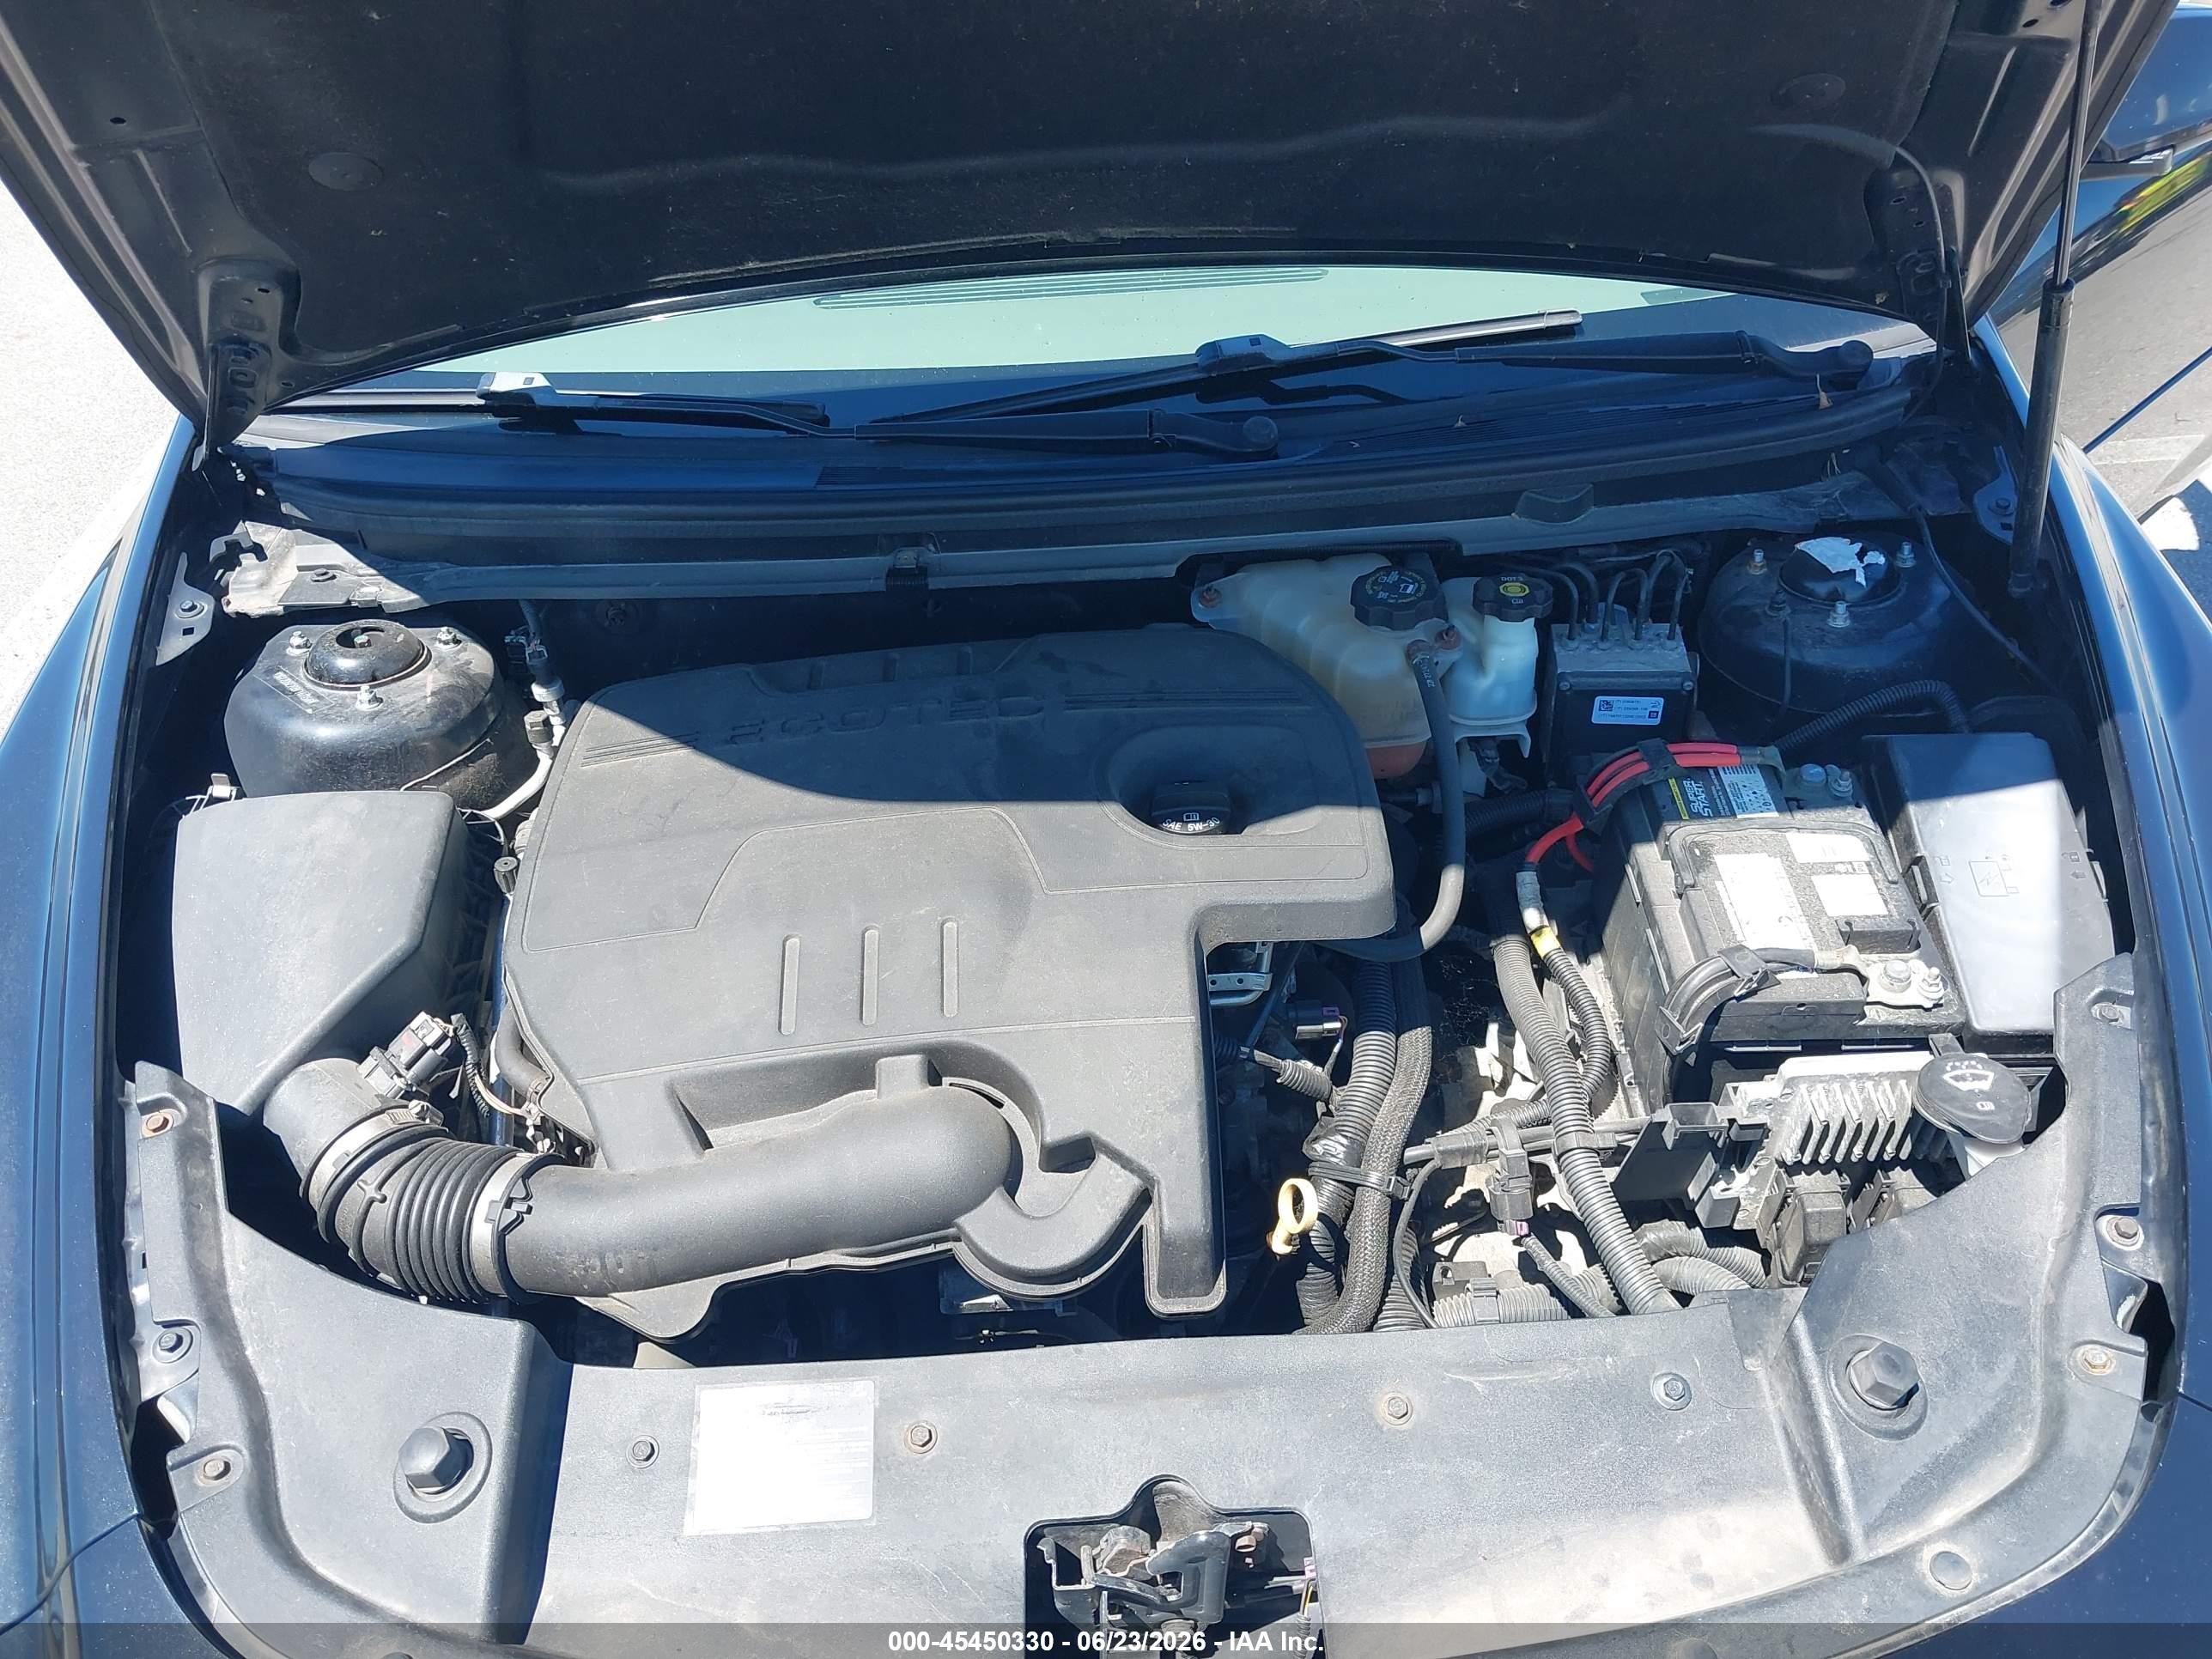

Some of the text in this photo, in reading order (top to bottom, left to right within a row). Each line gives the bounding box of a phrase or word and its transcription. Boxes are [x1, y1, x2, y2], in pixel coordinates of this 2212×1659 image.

[1683, 778, 1700, 812] SUPER
[1691, 781, 1713, 817] START
[1163, 817, 1220, 831] SAE 5W-30
